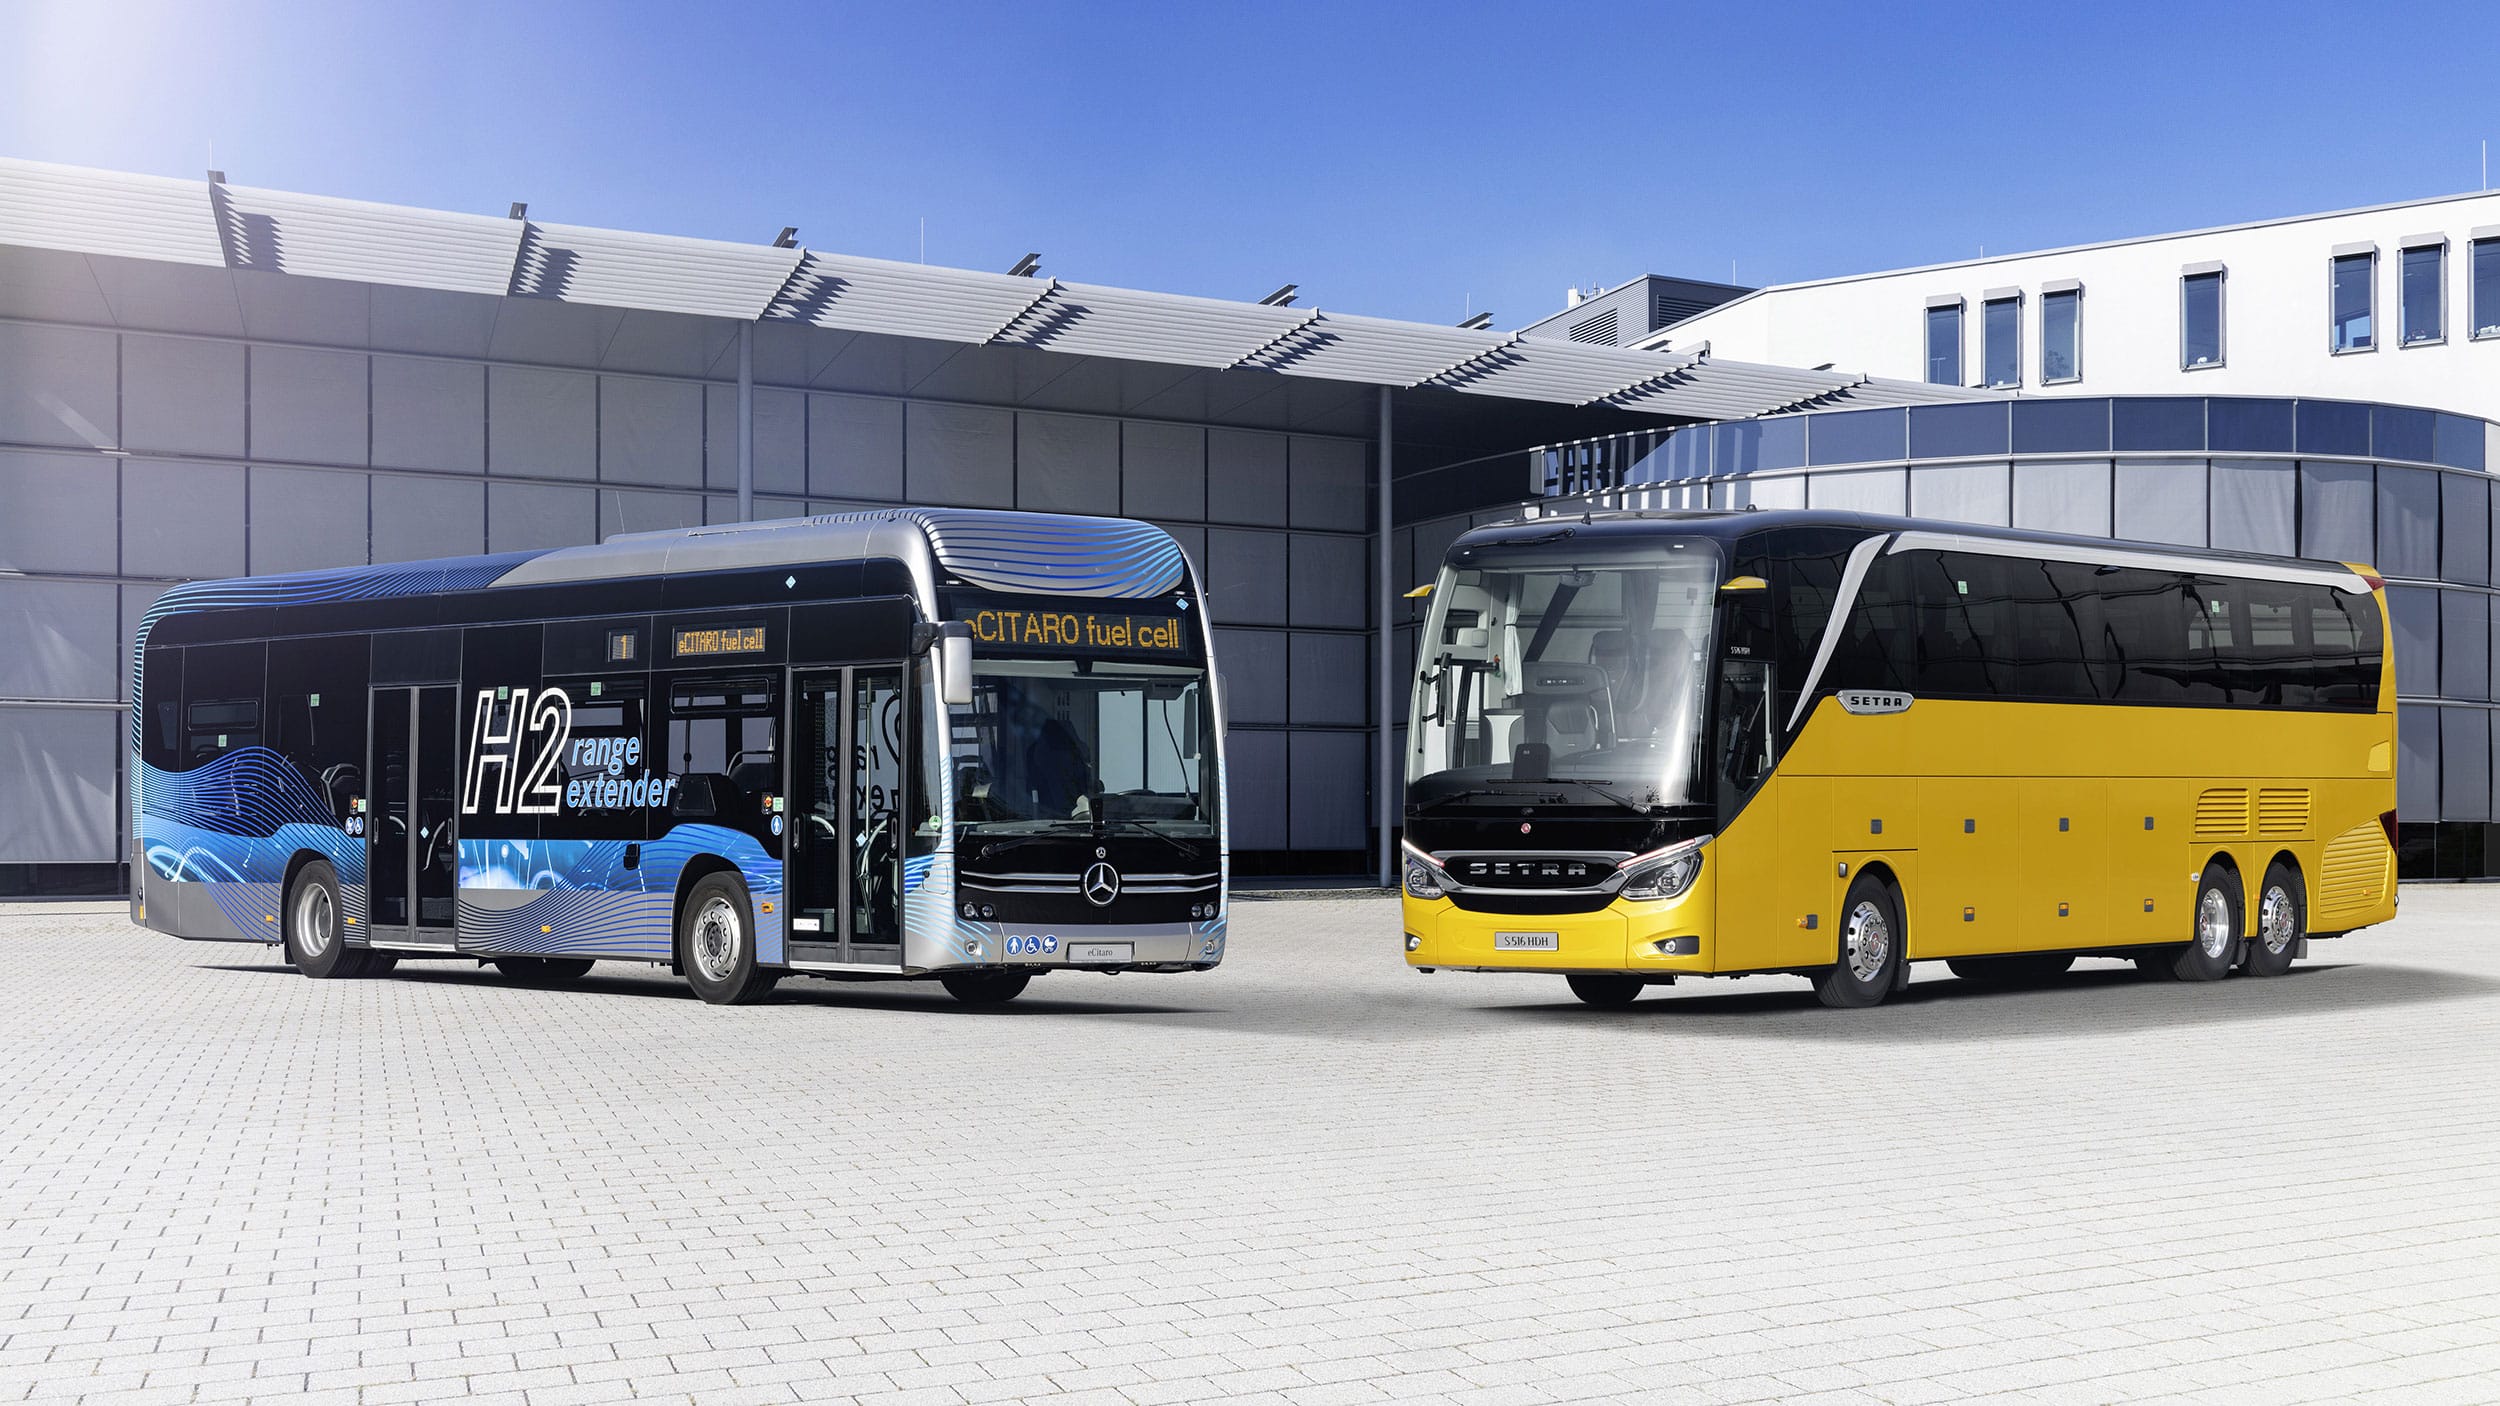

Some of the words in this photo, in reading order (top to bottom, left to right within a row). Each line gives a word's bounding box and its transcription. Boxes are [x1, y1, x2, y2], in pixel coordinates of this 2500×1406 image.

[679, 631, 719, 653] eCITARO
[721, 629, 741, 651] fuel
[743, 628, 763, 649] cell
[1086, 615, 1132, 647] fuel
[1137, 619, 1179, 649] cell
[620, 634, 627, 660] 1
[1850, 696, 1902, 707] SETRA
[462, 687, 572, 814] H2
[571, 736, 640, 775] range
[566, 768, 676, 808] extender
[1469, 863, 1586, 876] SETRA
[1087, 948, 1113, 957] eCitaro
[1504, 936, 1511, 946] S
[1511, 936, 1526, 946] 516
[1527, 936, 1548, 946] HDH
